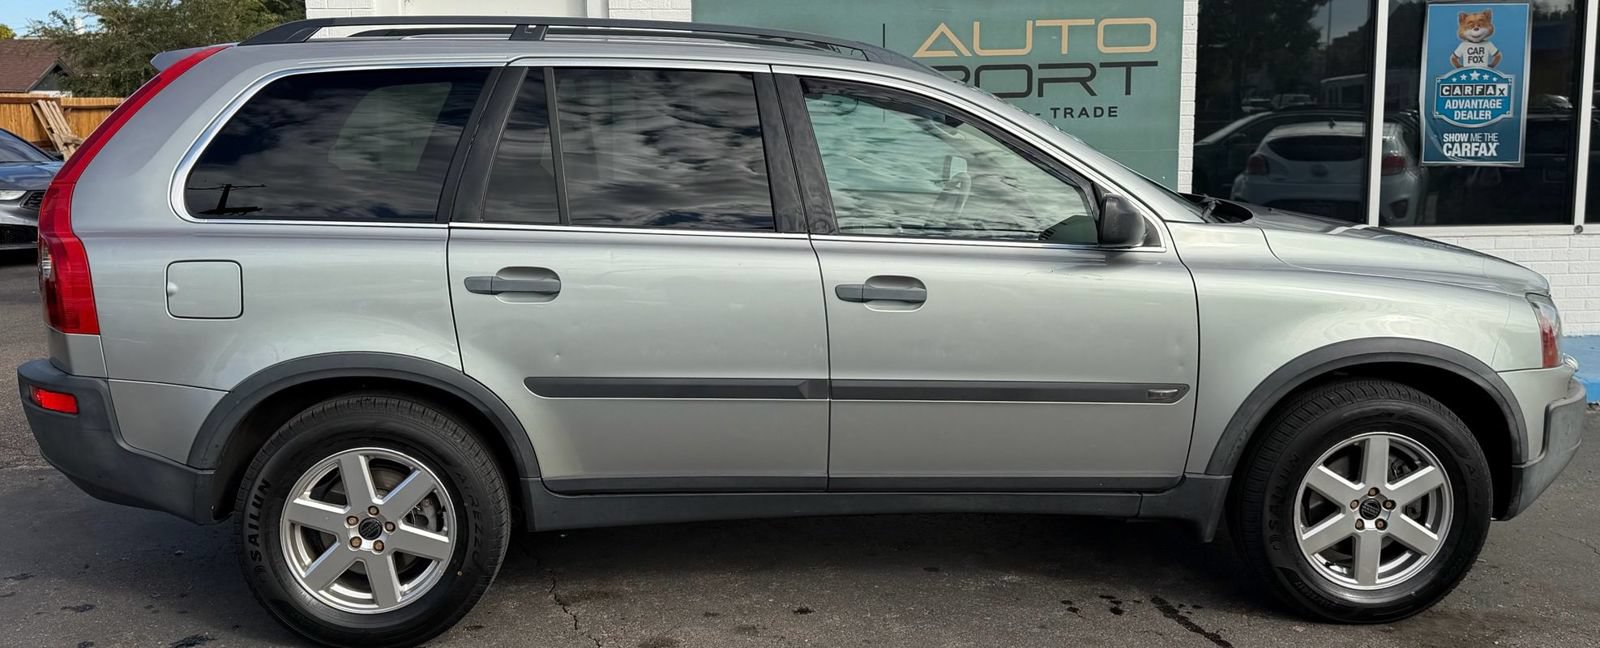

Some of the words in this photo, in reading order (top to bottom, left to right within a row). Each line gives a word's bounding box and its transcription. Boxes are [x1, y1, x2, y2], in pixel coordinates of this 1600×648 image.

[912, 17, 1157, 58] AUTO
[1467, 46, 1485, 55] CAR
[1467, 55, 1484, 64] FOX
[1441, 84, 1508, 97] CARFAX
[1445, 98, 1502, 110] ADVANTAGE
[1050, 106, 1119, 119] TRADE
[1454, 110, 1492, 121] DEALER
[1443, 133, 1469, 142] SHOW
[1470, 133, 1483, 142] ME
[1484, 133, 1499, 142] THE
[1443, 142, 1498, 157] CARFAX
[248, 478, 272, 562] SAILUN
